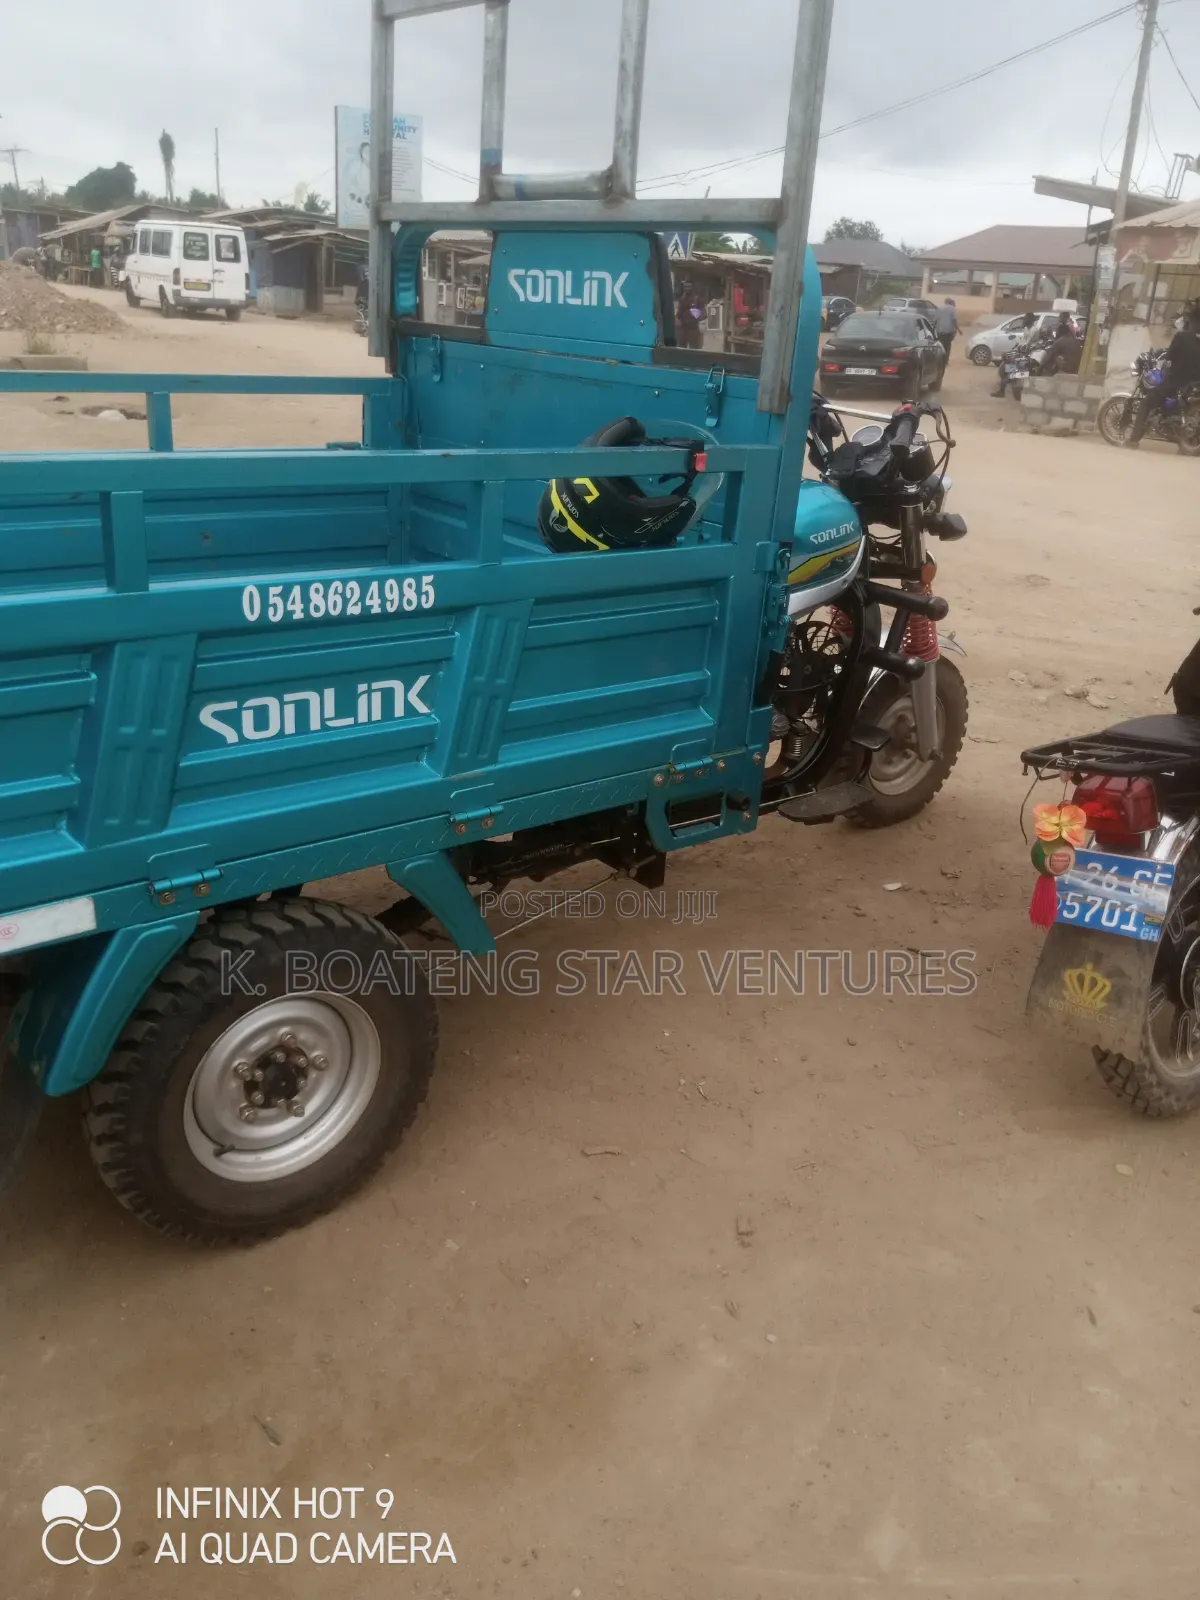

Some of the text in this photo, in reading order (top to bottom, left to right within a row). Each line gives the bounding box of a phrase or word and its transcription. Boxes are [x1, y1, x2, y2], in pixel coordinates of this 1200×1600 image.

[507, 268, 630, 308] SONLINK
[809, 522, 856, 545] SONLINK
[242, 574, 436, 623] 0548624985
[199, 674, 432, 744] SONLINK
[1139, 927, 1159, 941] GH
